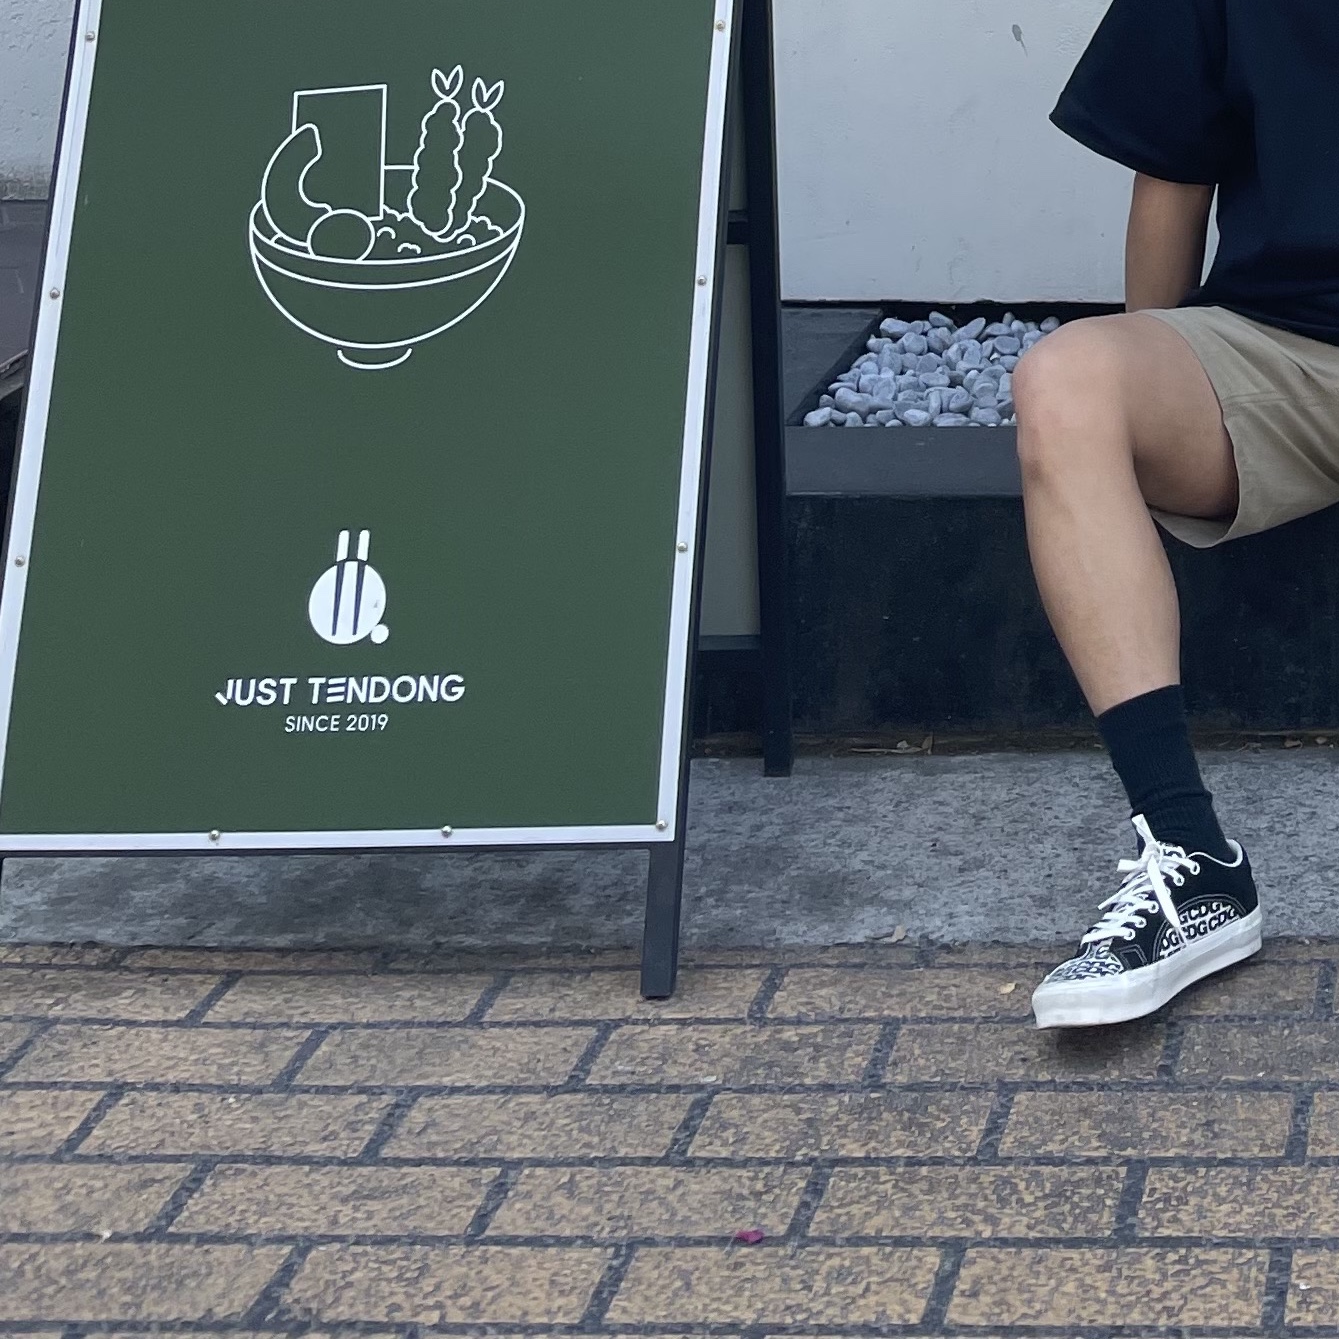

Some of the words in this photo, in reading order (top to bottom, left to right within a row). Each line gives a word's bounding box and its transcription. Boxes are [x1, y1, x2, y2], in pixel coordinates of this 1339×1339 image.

[214, 677, 298, 707] JUST
[308, 674, 467, 705] TENDONG
[284, 715, 341, 734] SINCE
[345, 713, 389, 733] 2019
